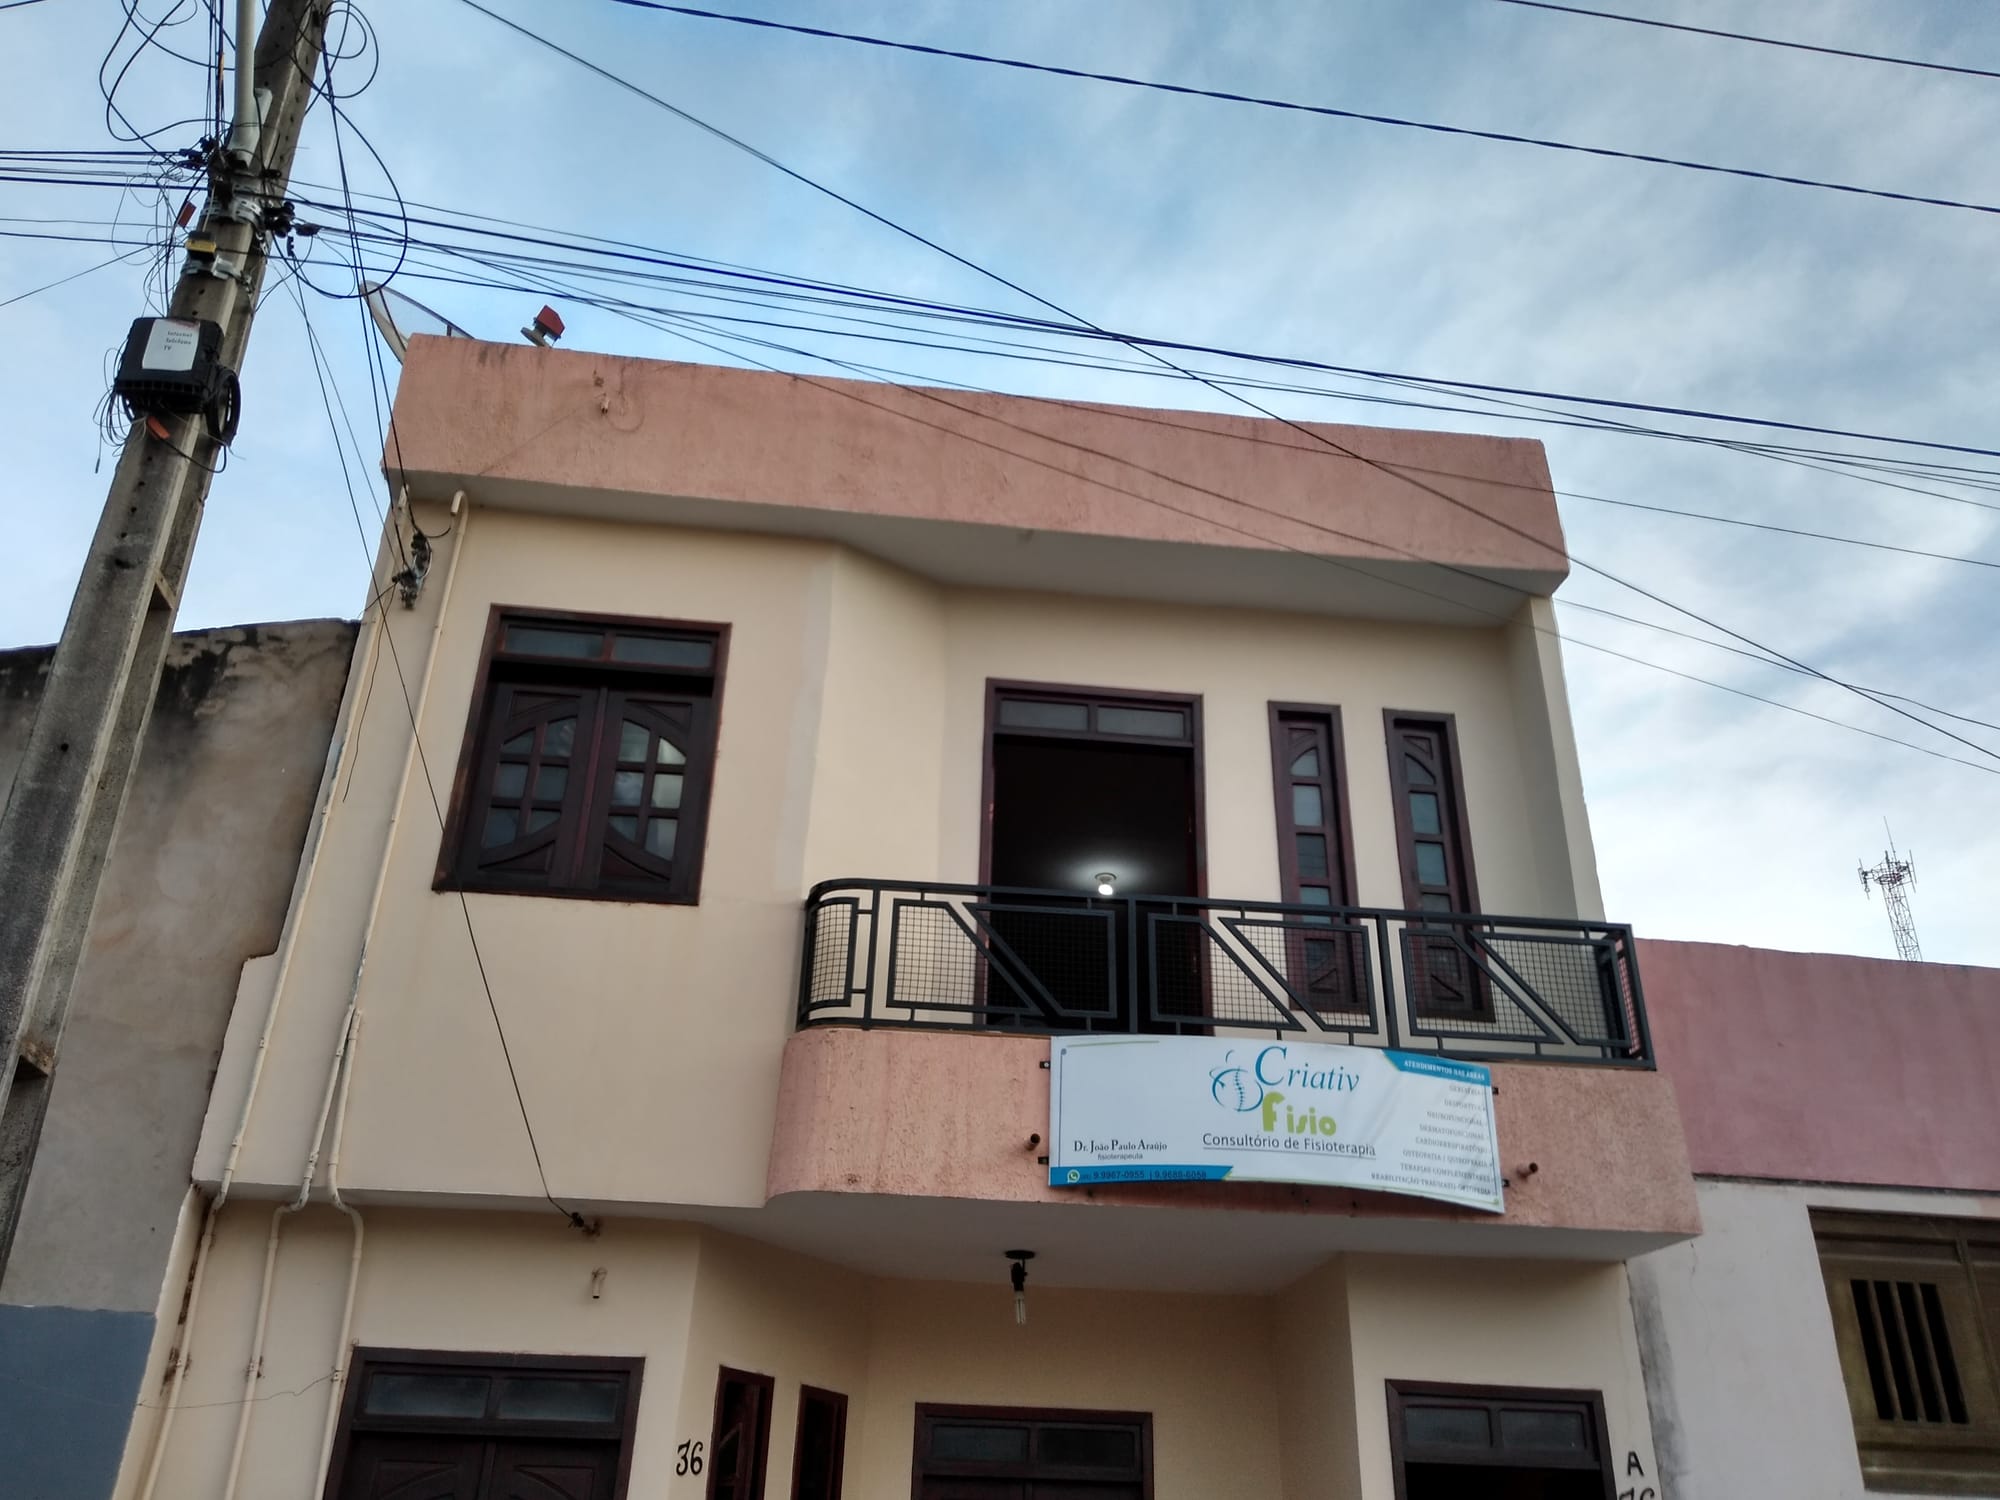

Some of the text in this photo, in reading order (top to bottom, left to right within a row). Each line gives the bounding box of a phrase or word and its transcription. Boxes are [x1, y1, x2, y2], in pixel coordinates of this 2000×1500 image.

[1255, 1046, 1360, 1093] Criativ
[1074, 1139, 1168, 1152] Dr. João Paulo Araújo
[1202, 1133, 1377, 1158] Consultório de Fisioterapia
[676, 1438, 704, 1476] 36
[1627, 1450, 1645, 1477] A
